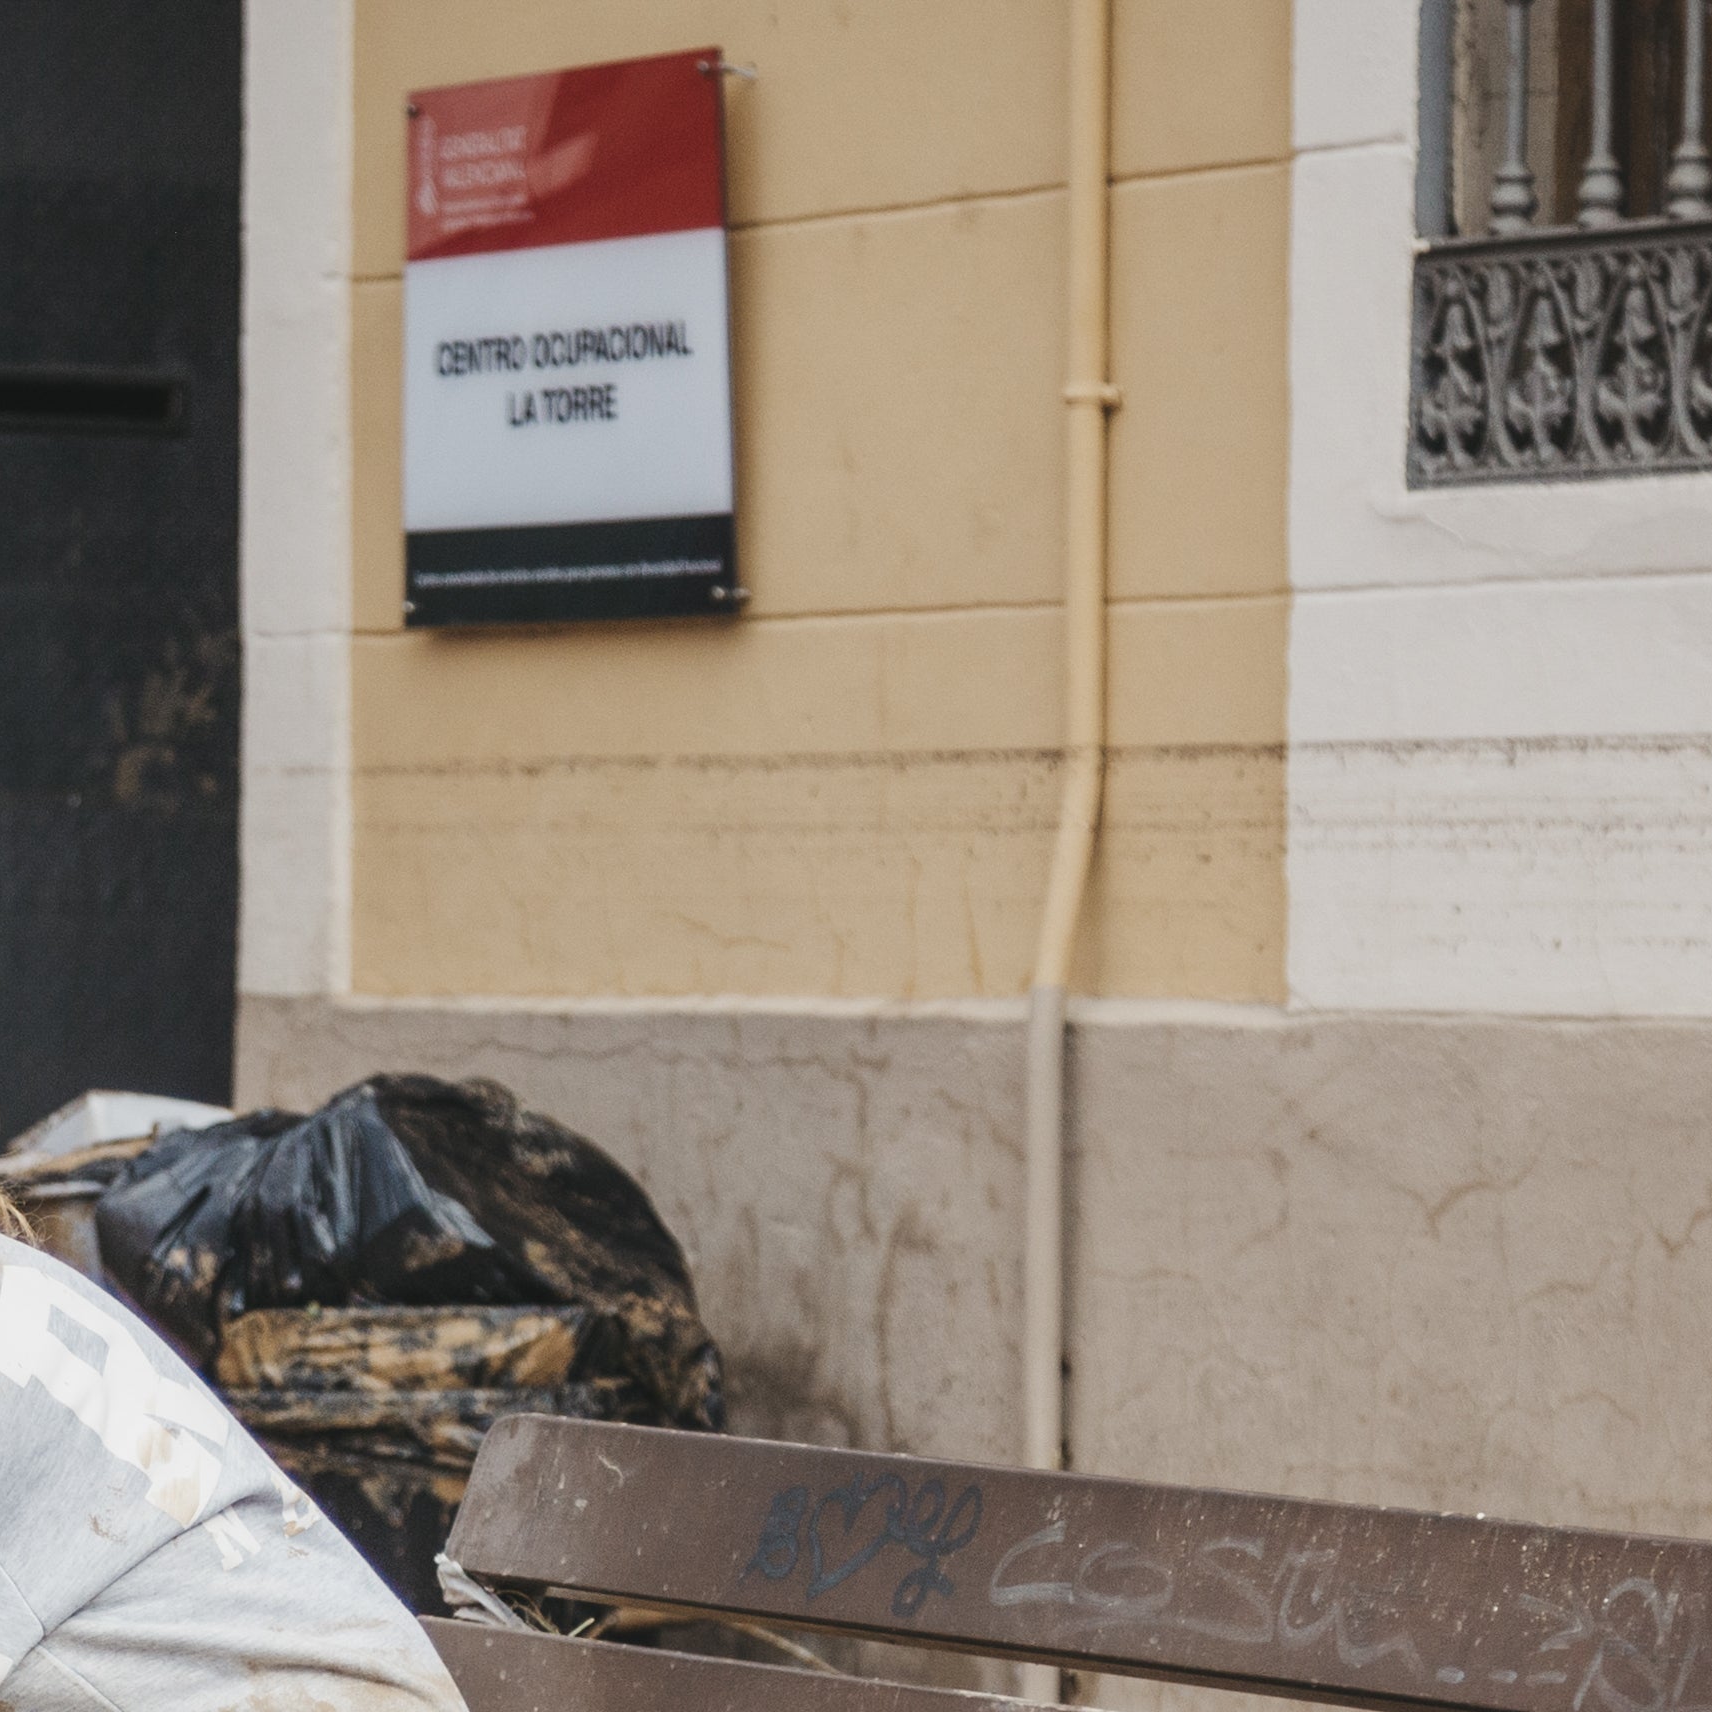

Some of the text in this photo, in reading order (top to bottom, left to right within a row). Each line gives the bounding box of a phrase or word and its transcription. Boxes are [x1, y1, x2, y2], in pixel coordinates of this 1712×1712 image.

[436, 320, 693, 376] CENTRO OCUPACIONAL
[506, 383, 619, 426] LA TORRE
